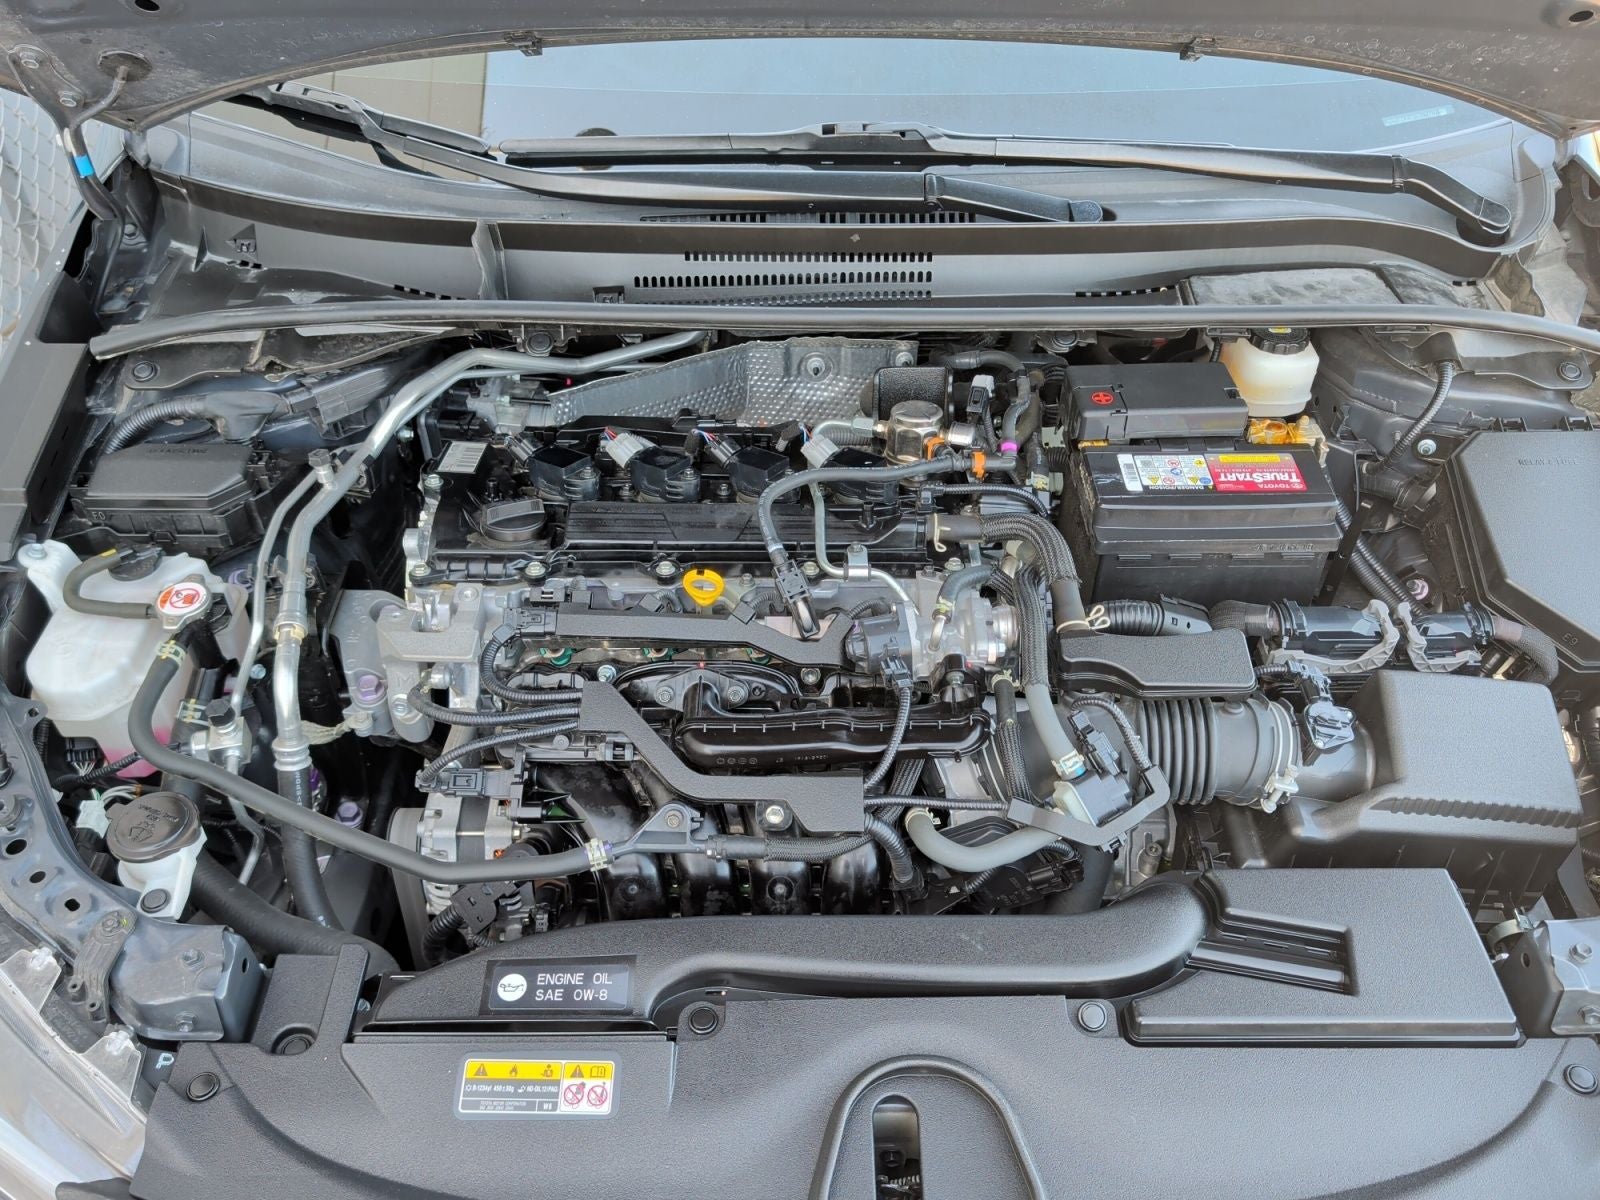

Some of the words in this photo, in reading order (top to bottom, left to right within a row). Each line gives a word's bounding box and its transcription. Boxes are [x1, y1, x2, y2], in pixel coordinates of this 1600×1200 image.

[537, 973, 584, 985] ENGINE
[593, 973, 613, 985] OIL
[535, 989, 564, 1001] SAE
